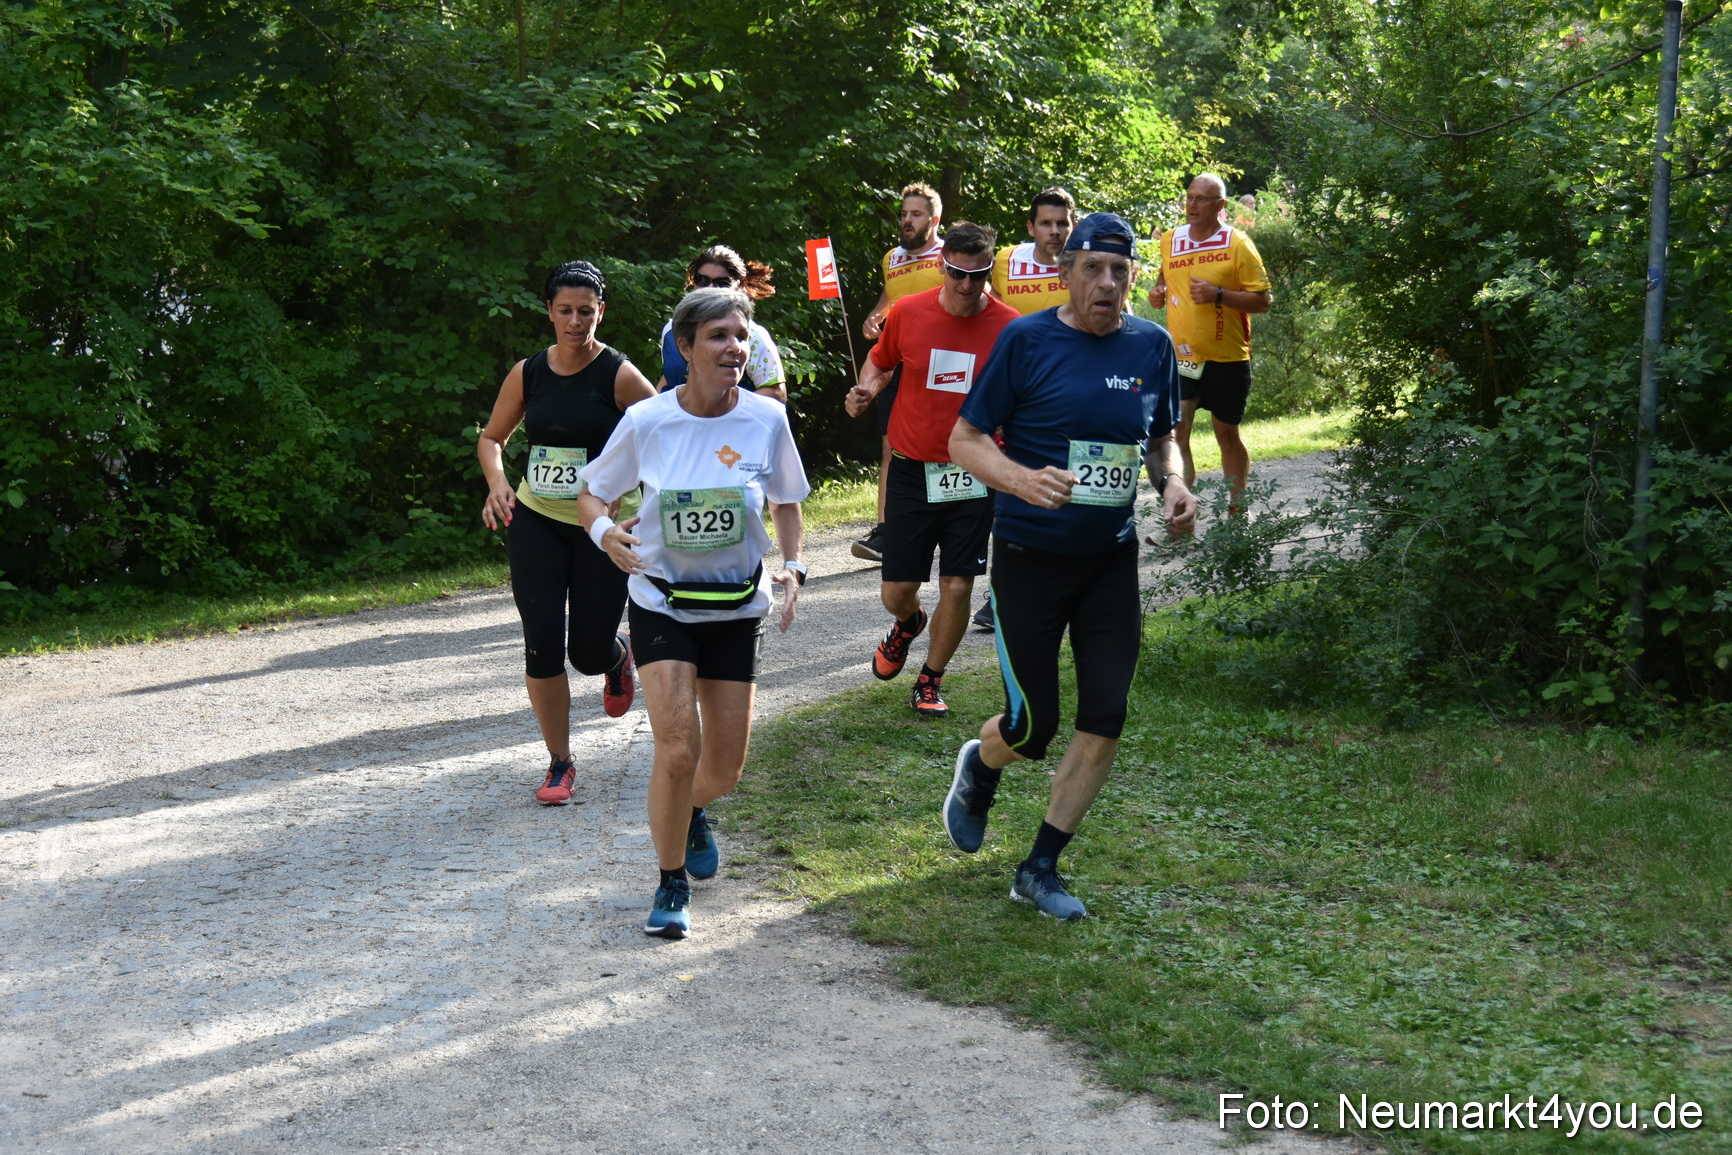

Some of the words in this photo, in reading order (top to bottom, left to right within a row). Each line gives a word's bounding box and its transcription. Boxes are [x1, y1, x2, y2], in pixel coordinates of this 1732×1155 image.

[1169, 257, 1194, 270] MAX
[1198, 253, 1231, 264] BÖGL
[887, 267, 912, 281] MAX
[1007, 284, 1042, 295] MAX
[1105, 375, 1130, 390] vhs
[533, 464, 577, 485] 1723
[939, 472, 973, 489] 475
[1078, 464, 1132, 489] 2399
[670, 509, 735, 534] 1329
